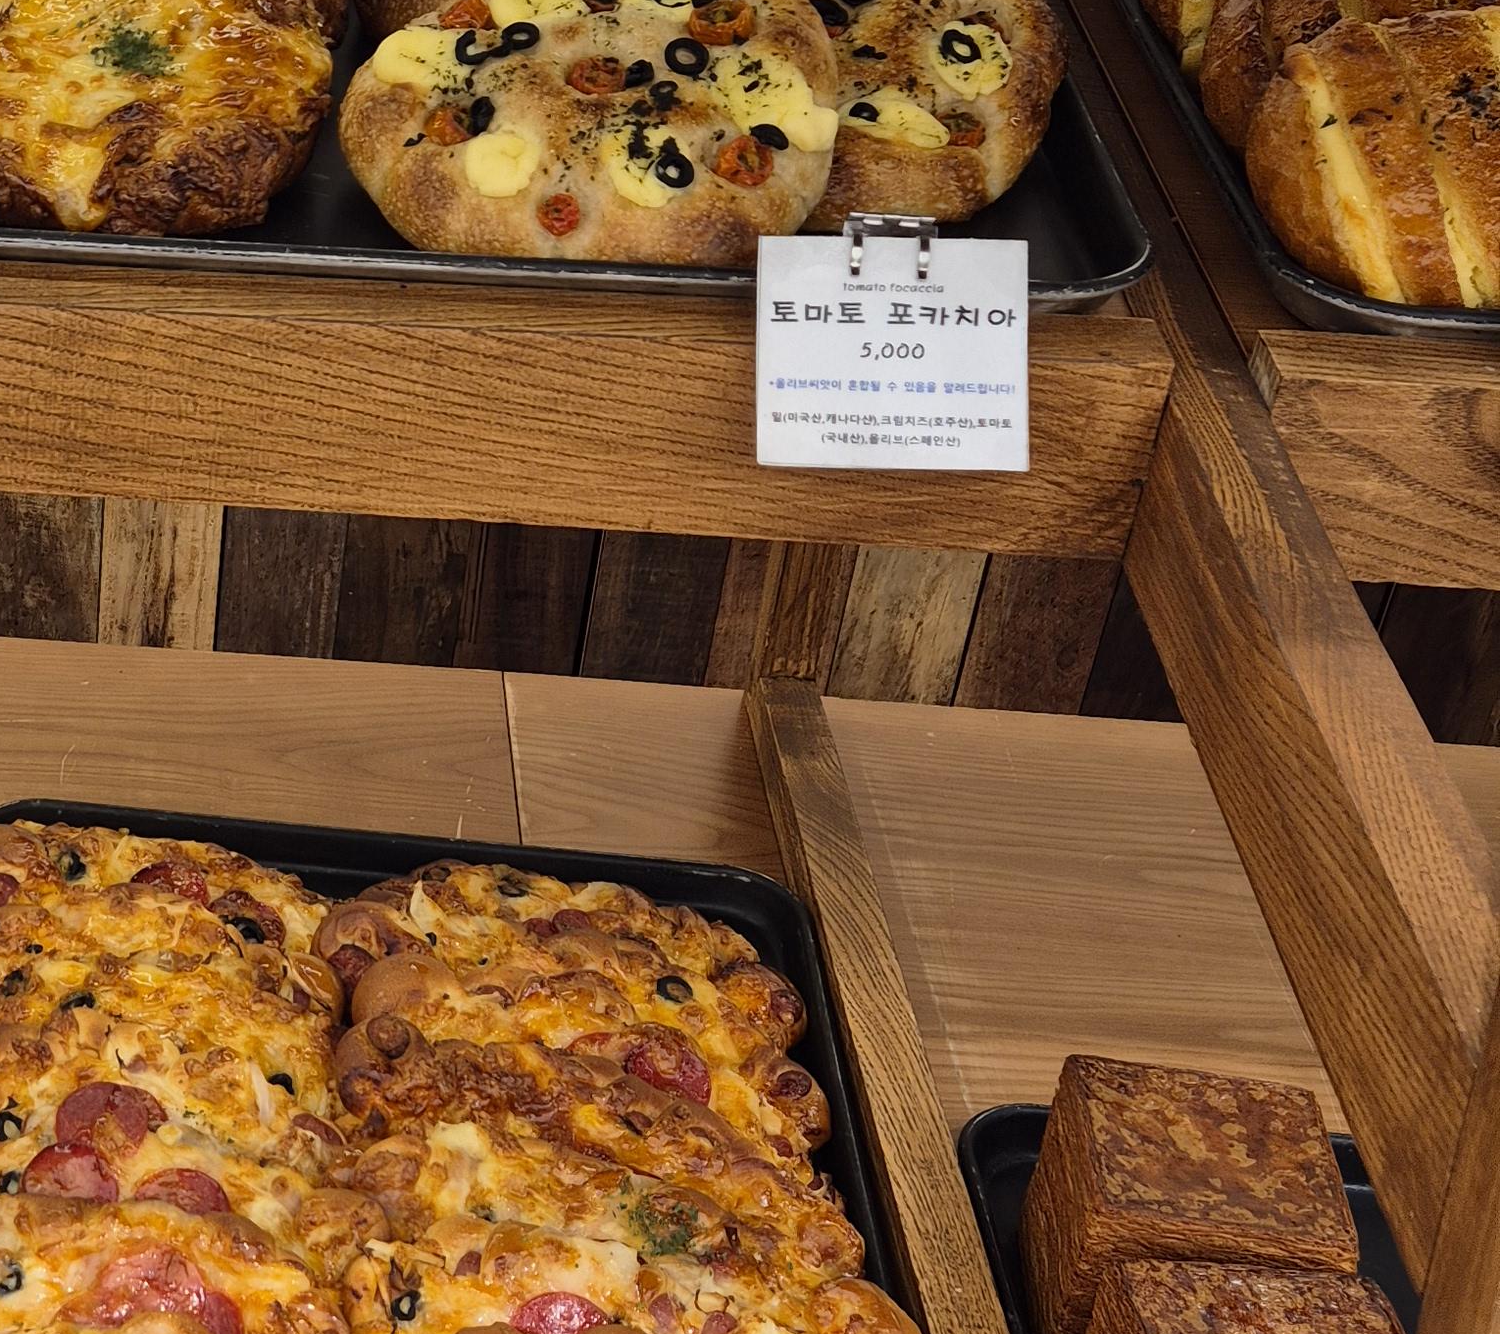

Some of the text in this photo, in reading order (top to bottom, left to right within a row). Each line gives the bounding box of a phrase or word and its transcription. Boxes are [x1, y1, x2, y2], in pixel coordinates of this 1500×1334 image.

[890, 282, 944, 294] focaccia
[770, 300, 1017, 327] 토마토 포카치아
[859, 342, 926, 361] 5,000
[887, 381, 899, 393] 수
